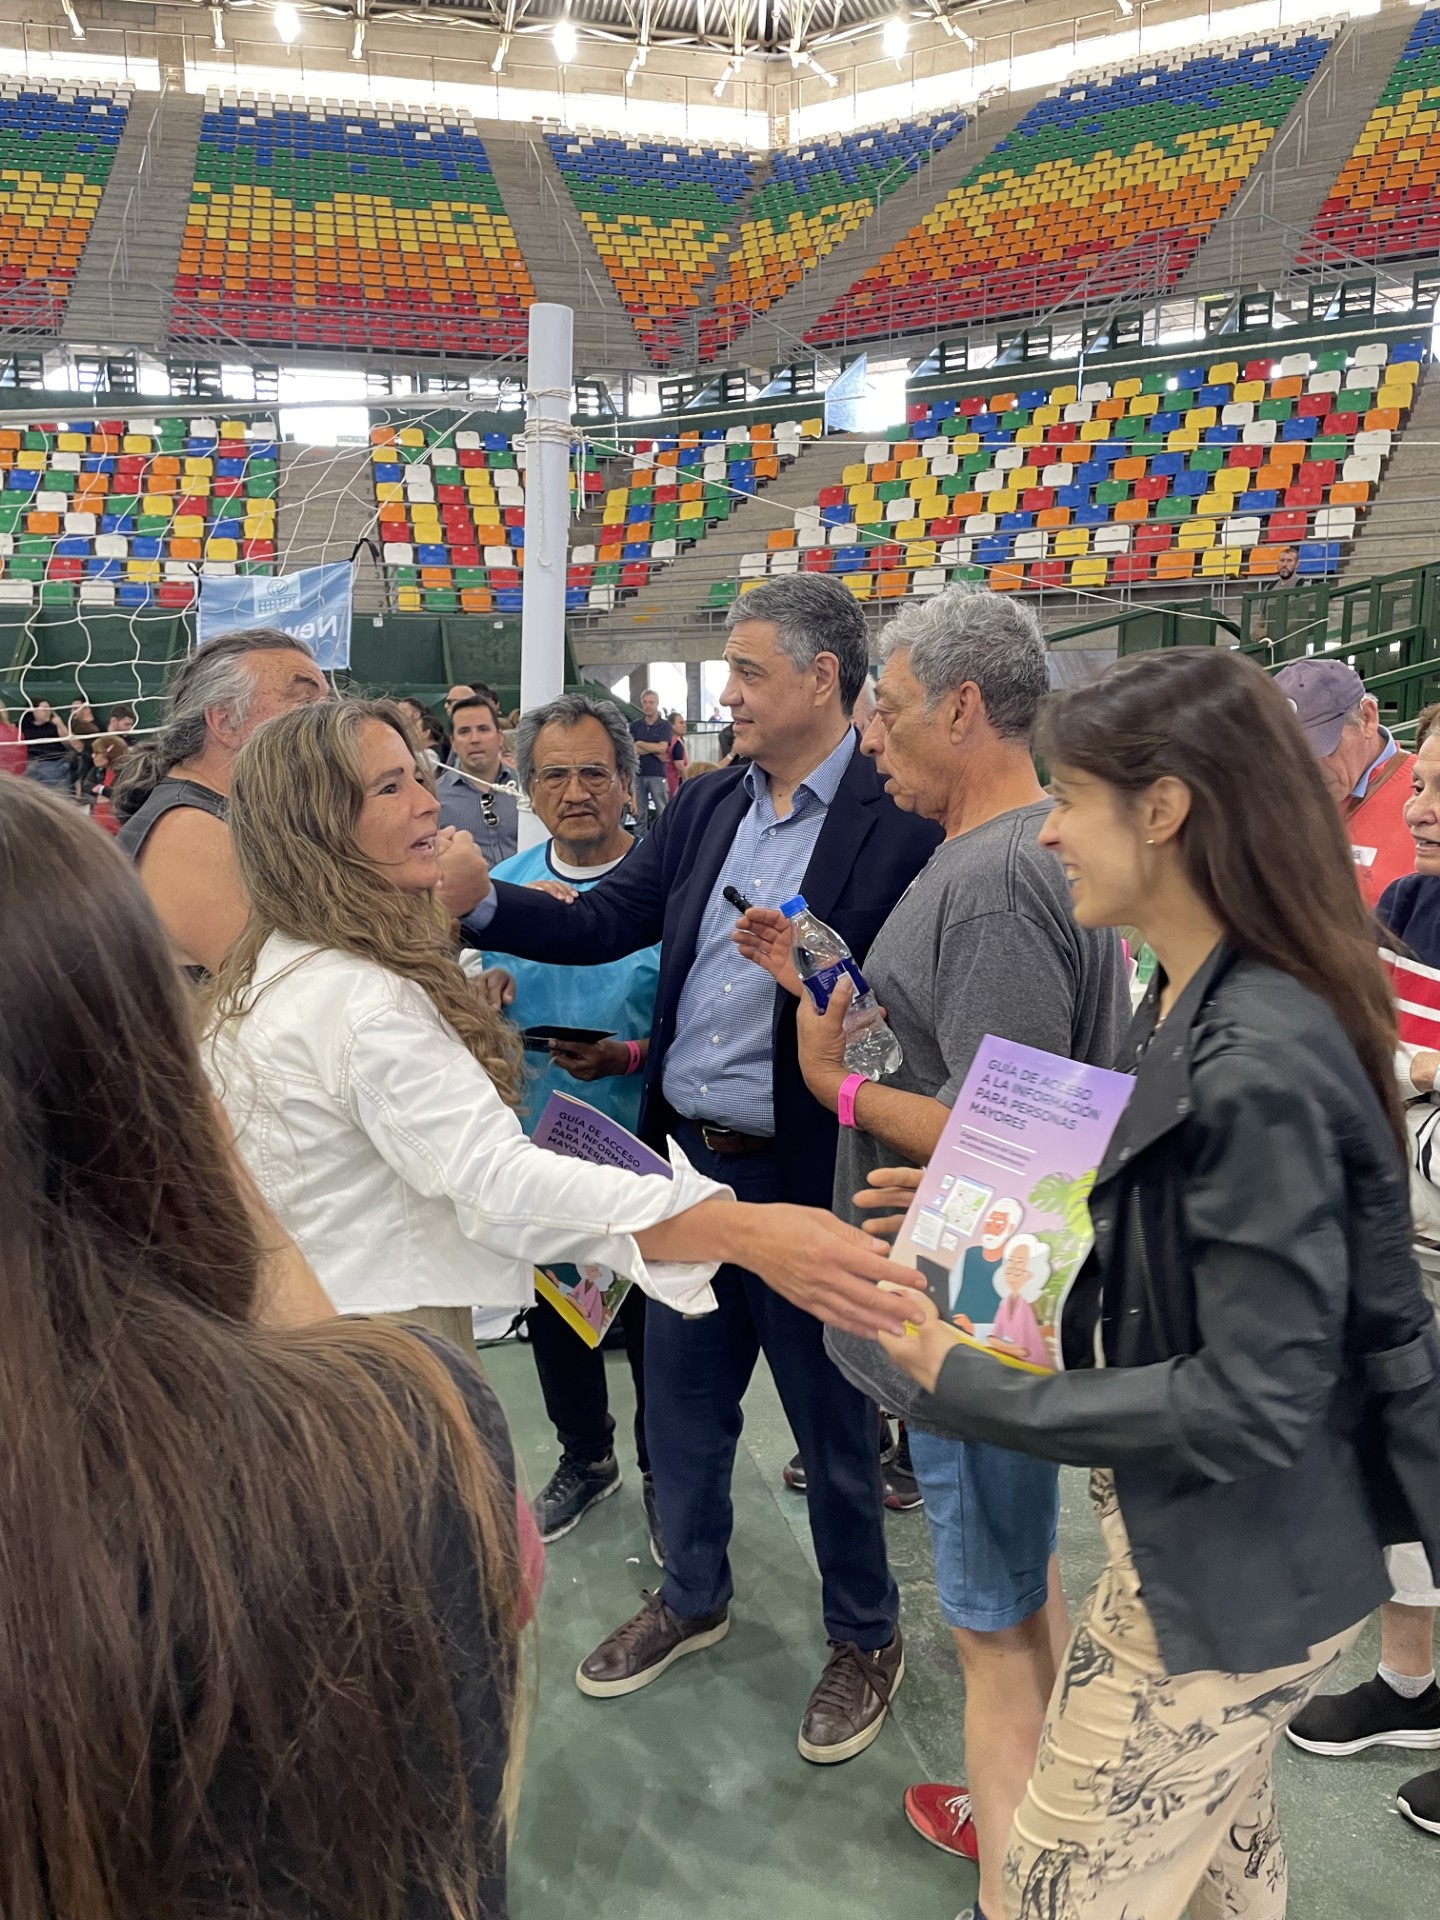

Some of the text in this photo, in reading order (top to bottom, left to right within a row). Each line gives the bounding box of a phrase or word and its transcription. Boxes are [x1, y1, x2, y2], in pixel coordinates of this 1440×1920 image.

[981, 1073, 1102, 1121] A LA INFORMACIÓN
[988, 1059, 1093, 1101] GUÍA DE ACCESO
[969, 1101, 1028, 1130] MAYORES
[975, 1087, 1079, 1130] PARA PERSONAS
[547, 1136, 590, 1161] MAYORE
[551, 1127, 611, 1165] PARA PERS
[555, 1120, 633, 1170] A LA INFORMAC
[559, 1111, 640, 1168] GUÍA DE ACCESO
